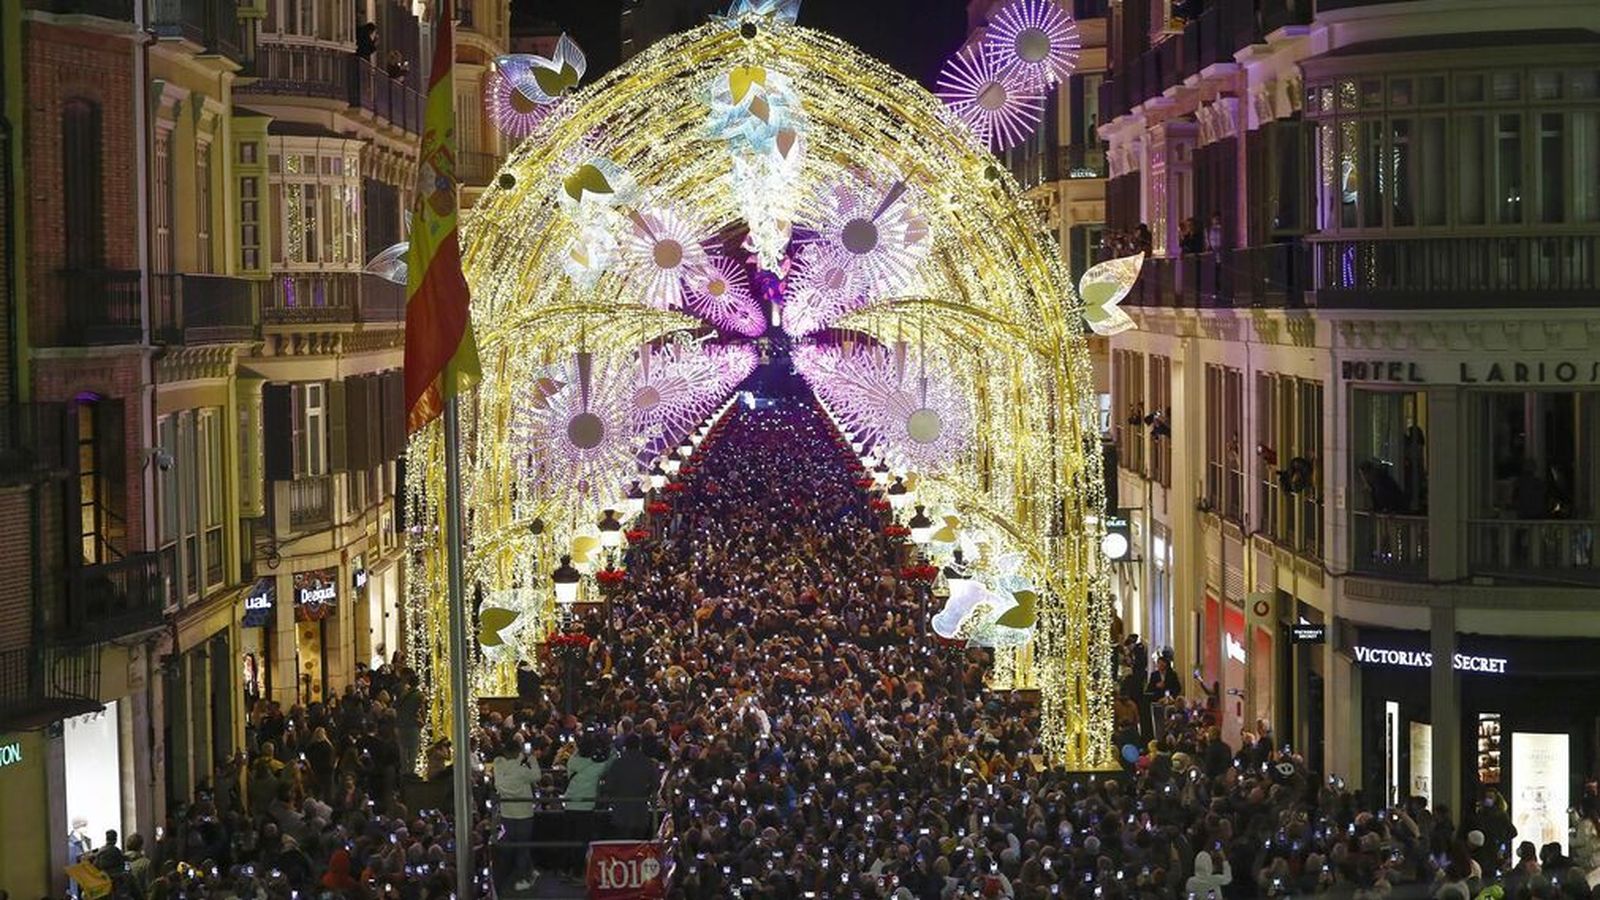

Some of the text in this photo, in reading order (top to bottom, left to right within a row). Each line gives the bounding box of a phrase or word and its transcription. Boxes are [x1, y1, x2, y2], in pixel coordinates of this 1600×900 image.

[1341, 360, 1425, 382] HOTEL
[1354, 646, 1508, 673] VICTORIA'S SECRET
